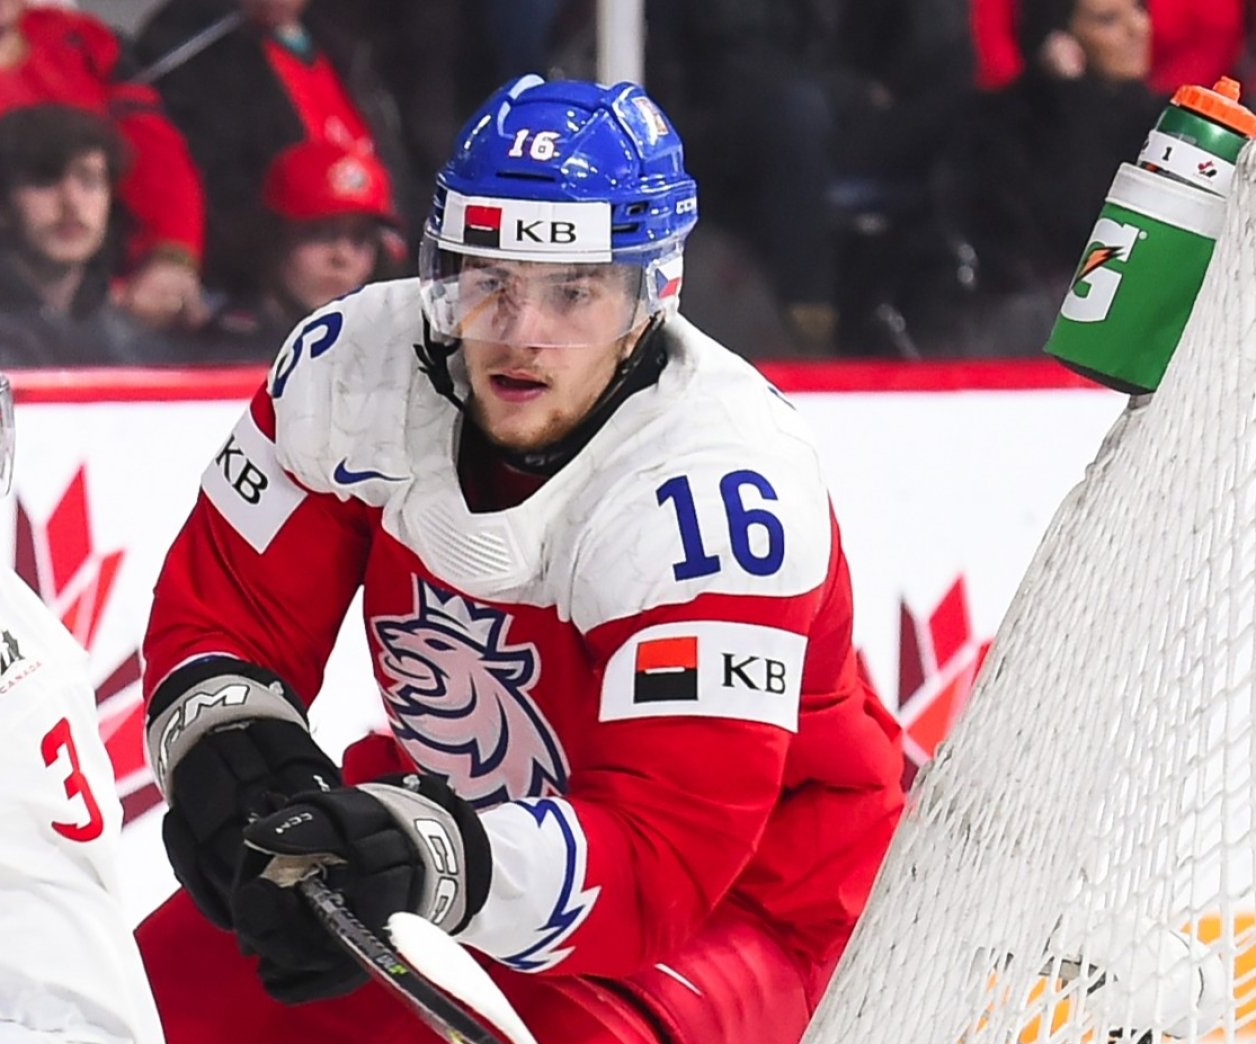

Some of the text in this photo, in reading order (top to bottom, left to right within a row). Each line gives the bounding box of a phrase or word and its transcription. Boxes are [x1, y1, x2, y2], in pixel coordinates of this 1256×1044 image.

[508, 129, 561, 162] 16
[1161, 146, 1173, 162] 1
[515, 219, 577, 244] KB
[676, 197, 697, 215] CC
[272, 300, 352, 398] 6
[215, 434, 268, 505] KB
[655, 469, 785, 582] 16
[720, 652, 786, 695] KB
[157, 684, 250, 786] CM
[40, 716, 104, 843] 3
[414, 818, 459, 925] CC
